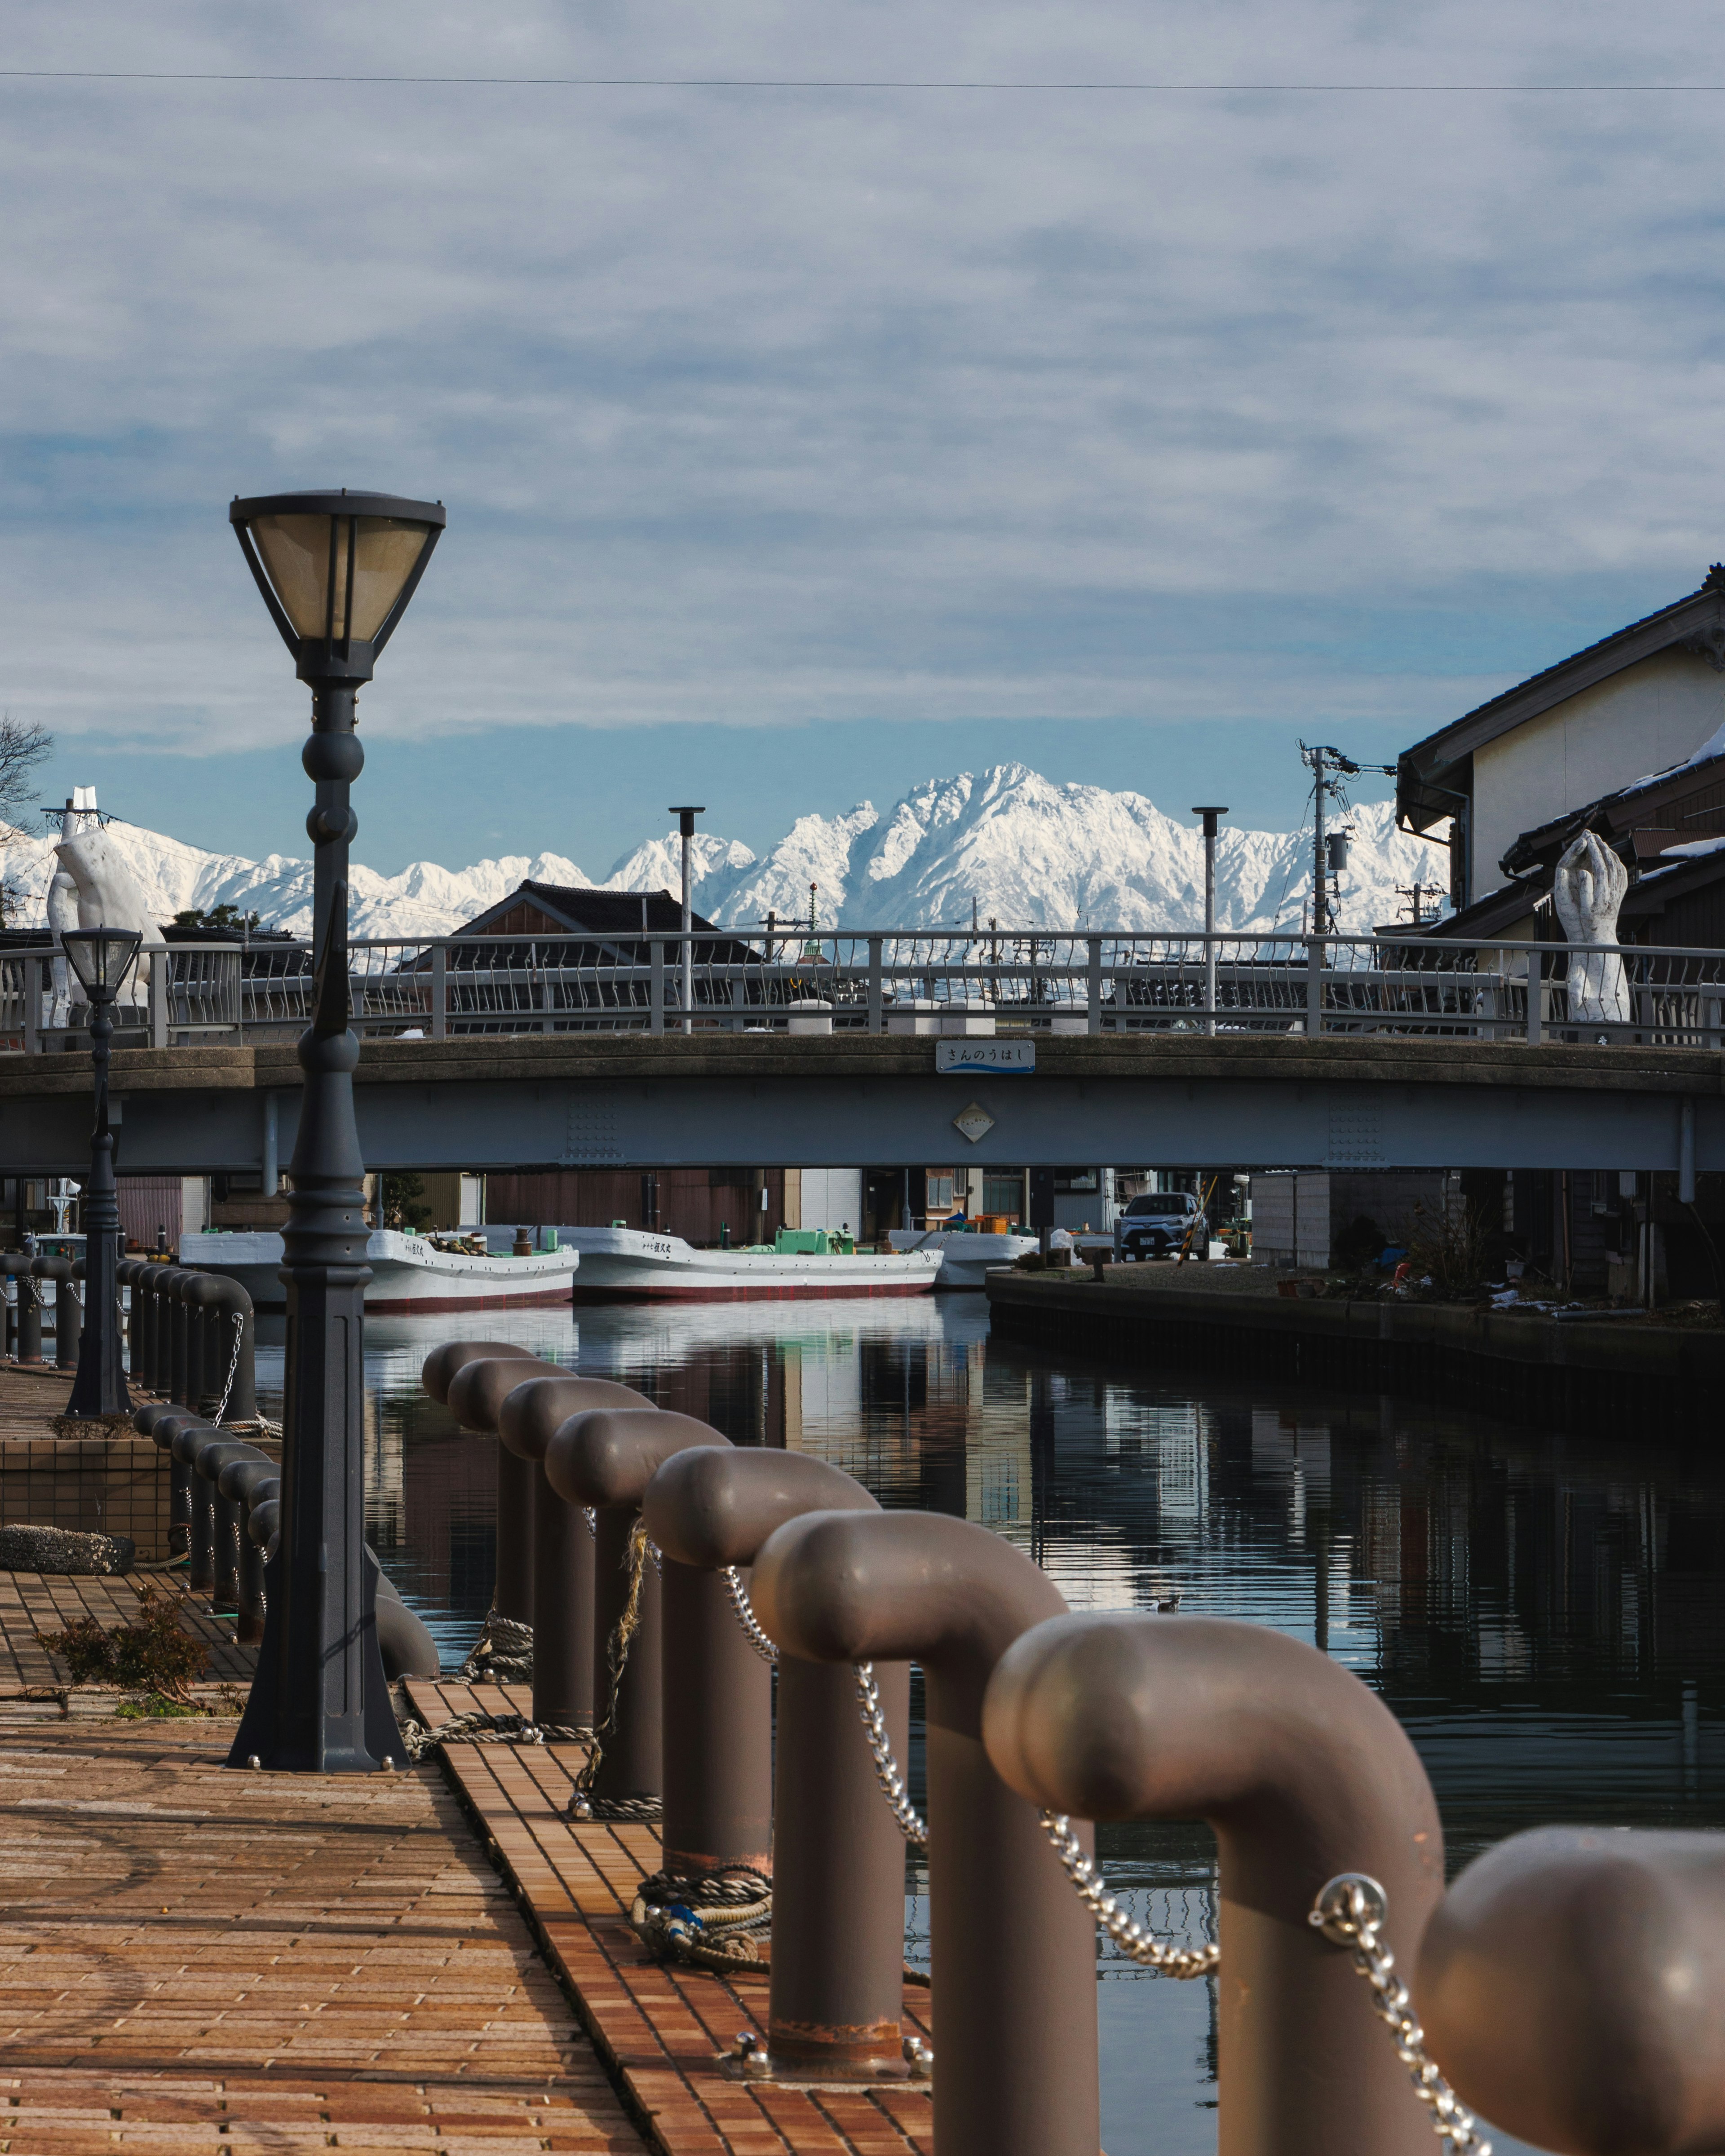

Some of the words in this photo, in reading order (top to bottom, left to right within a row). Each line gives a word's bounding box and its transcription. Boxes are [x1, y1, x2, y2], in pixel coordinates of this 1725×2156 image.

[948, 1049, 1022, 1061] さんのうはし
